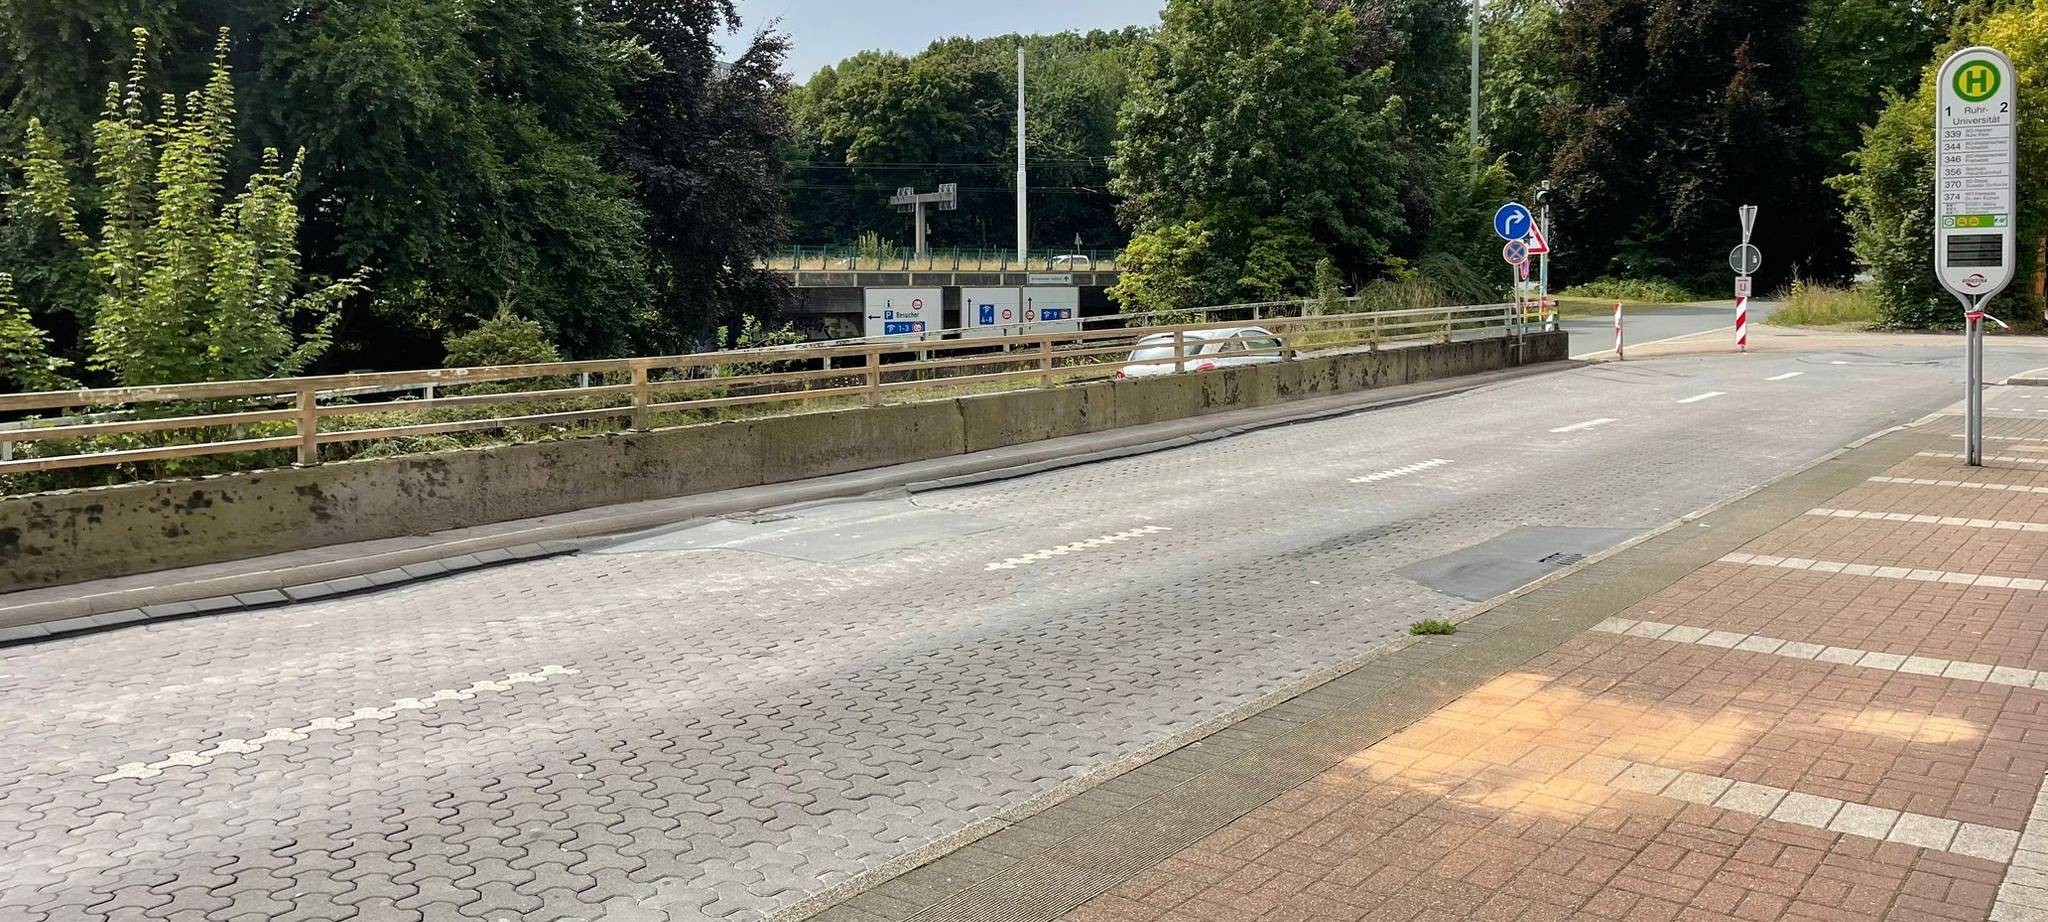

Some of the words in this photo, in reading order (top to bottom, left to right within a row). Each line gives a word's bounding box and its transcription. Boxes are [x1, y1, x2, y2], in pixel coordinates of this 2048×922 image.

[1966, 69, 1987, 93] H
[1945, 106, 1951, 117] 1
[1964, 106, 1989, 114] Ruhr-
[2000, 102, 2008, 113] 2
[1953, 115, 2000, 126] Universität
[1944, 130, 1961, 138] 339
[1944, 143, 1961, 151] 344
[1944, 168, 1961, 176] 356
[1944, 180, 1961, 188] 370
[1944, 193, 1960, 201] 374
[896, 311, 920, 319] Besucher
